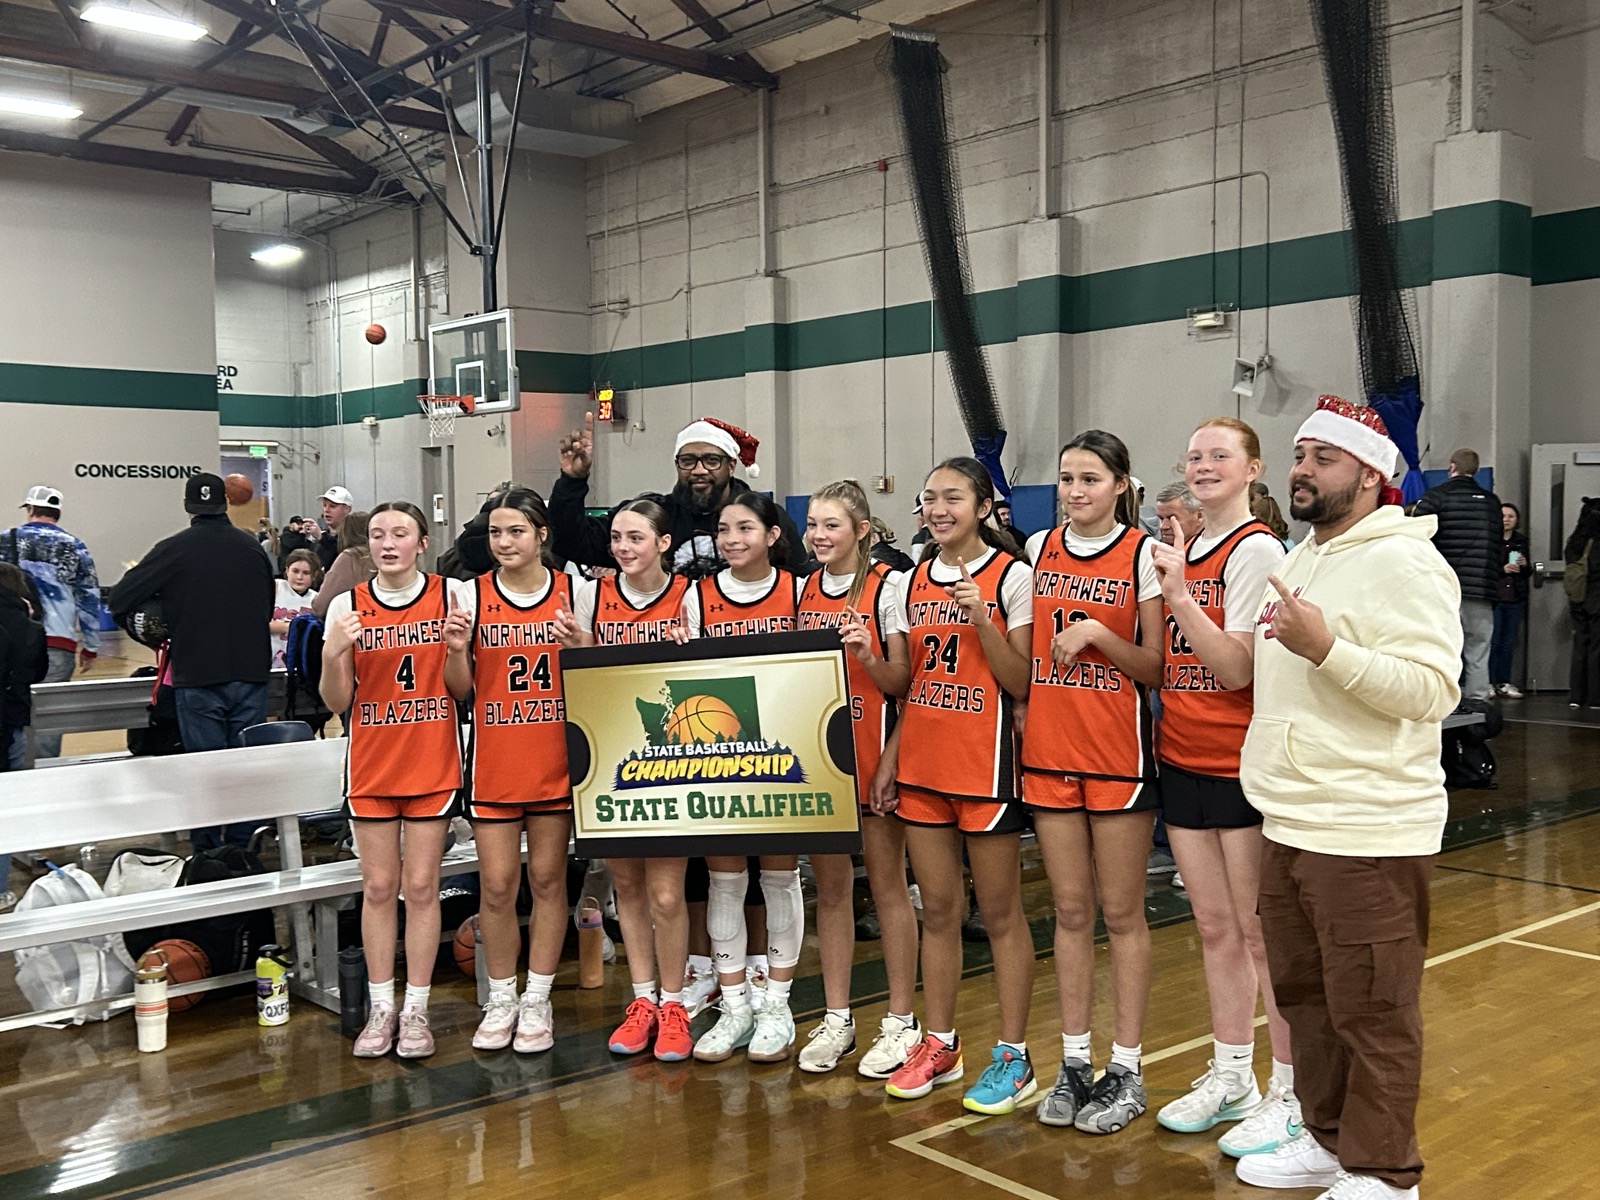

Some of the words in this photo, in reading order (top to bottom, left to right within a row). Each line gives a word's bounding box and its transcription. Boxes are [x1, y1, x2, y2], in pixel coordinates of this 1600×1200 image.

[75, 464, 202, 478] CONCESSIONS
[923, 633, 960, 675] 34
[395, 653, 416, 692] 4
[507, 653, 552, 693] 24
[360, 696, 449, 727] BLAZERS
[485, 698, 566, 726] BLAZER
[645, 744, 683, 758] STATE
[686, 741, 768, 756] BASKETBALL
[621, 753, 794, 782] CHAMPIONSHIP
[595, 795, 679, 822] STATE
[687, 791, 834, 819] QUALIFIER
